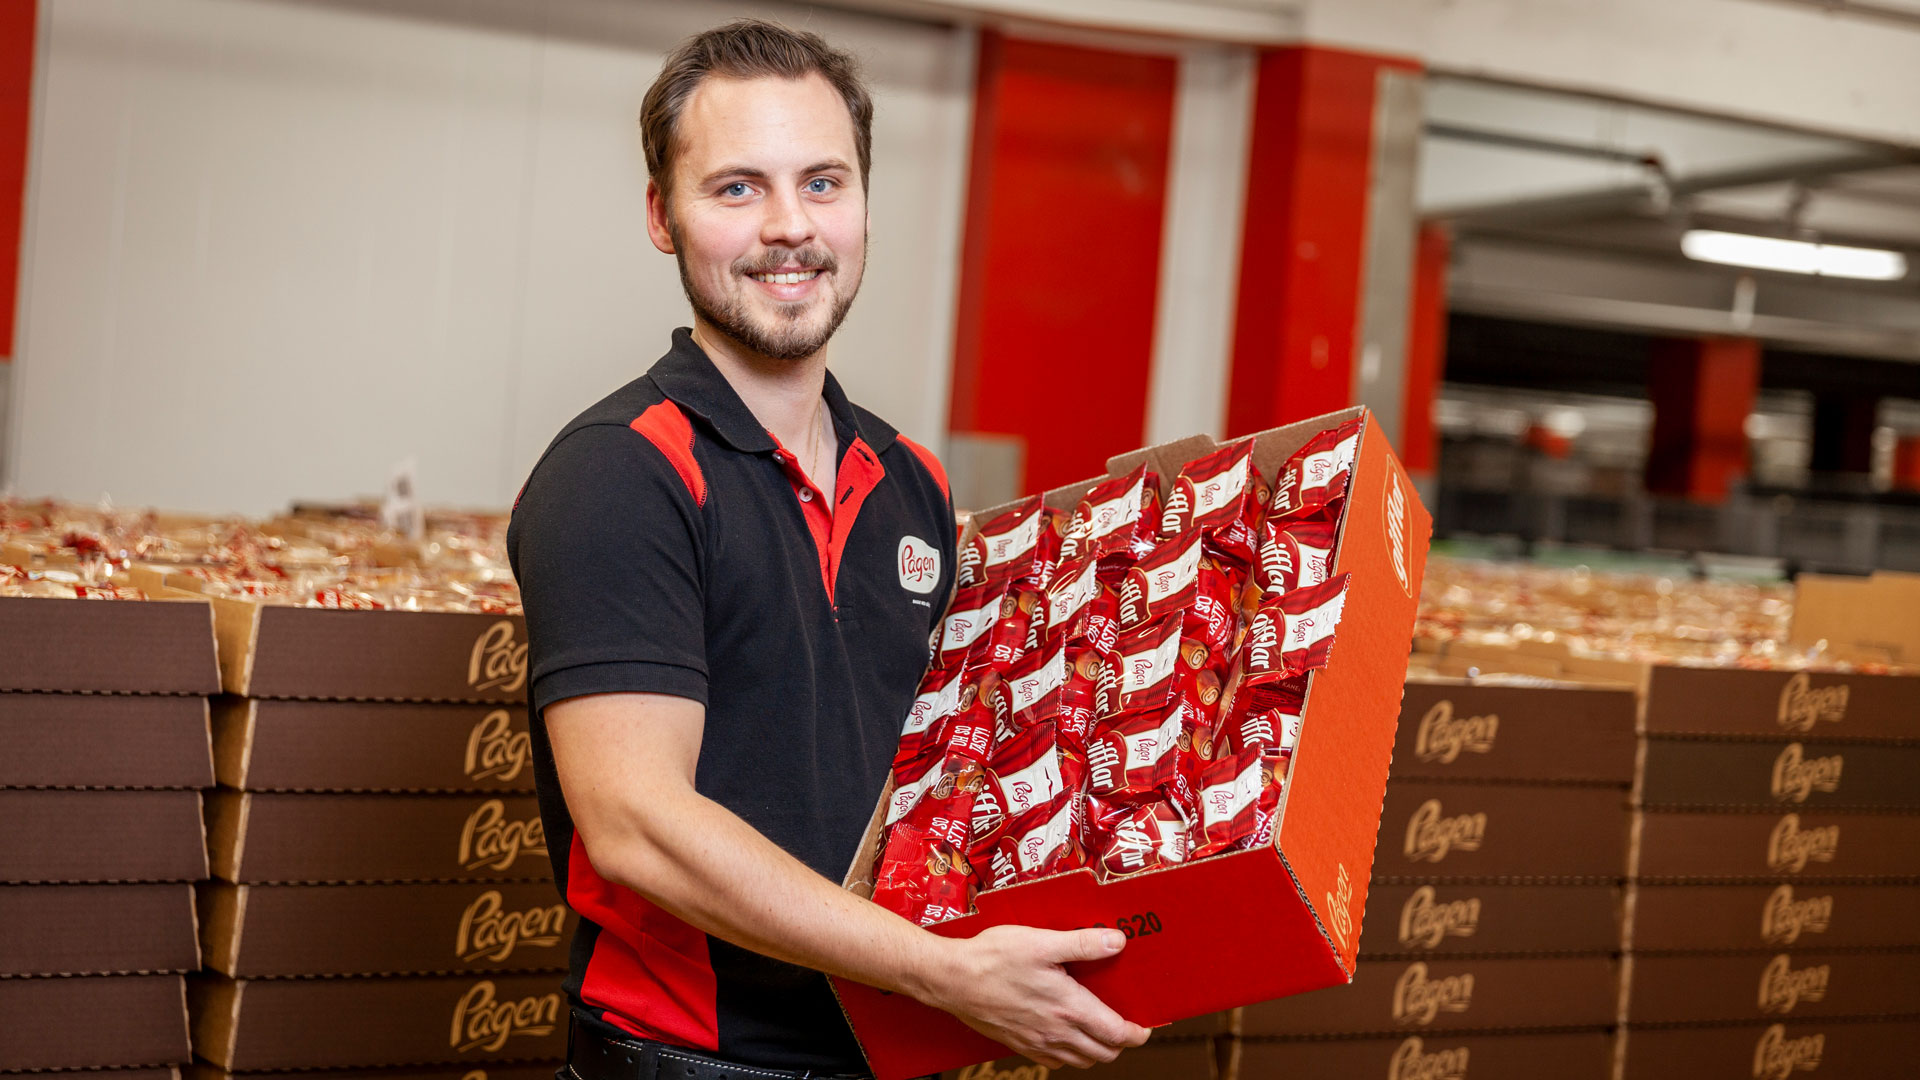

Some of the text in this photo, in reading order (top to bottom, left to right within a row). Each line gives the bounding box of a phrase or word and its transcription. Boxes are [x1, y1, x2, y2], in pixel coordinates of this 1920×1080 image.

[1162, 486, 1189, 534] ifflar
[959, 541, 983, 587] ifflar
[468, 620, 528, 692] Påg
[1095, 618, 1118, 655] TASTY!
[464, 709, 532, 782] Påg
[951, 724, 972, 747] OH SO
[969, 726, 991, 755] TASTY!
[458, 799, 545, 871] Påge
[930, 816, 950, 831] SO
[946, 819, 967, 849] STY!
[456, 890, 567, 963] Pågen
[926, 903, 945, 917] SO
[450, 980, 560, 1052] Pågen
